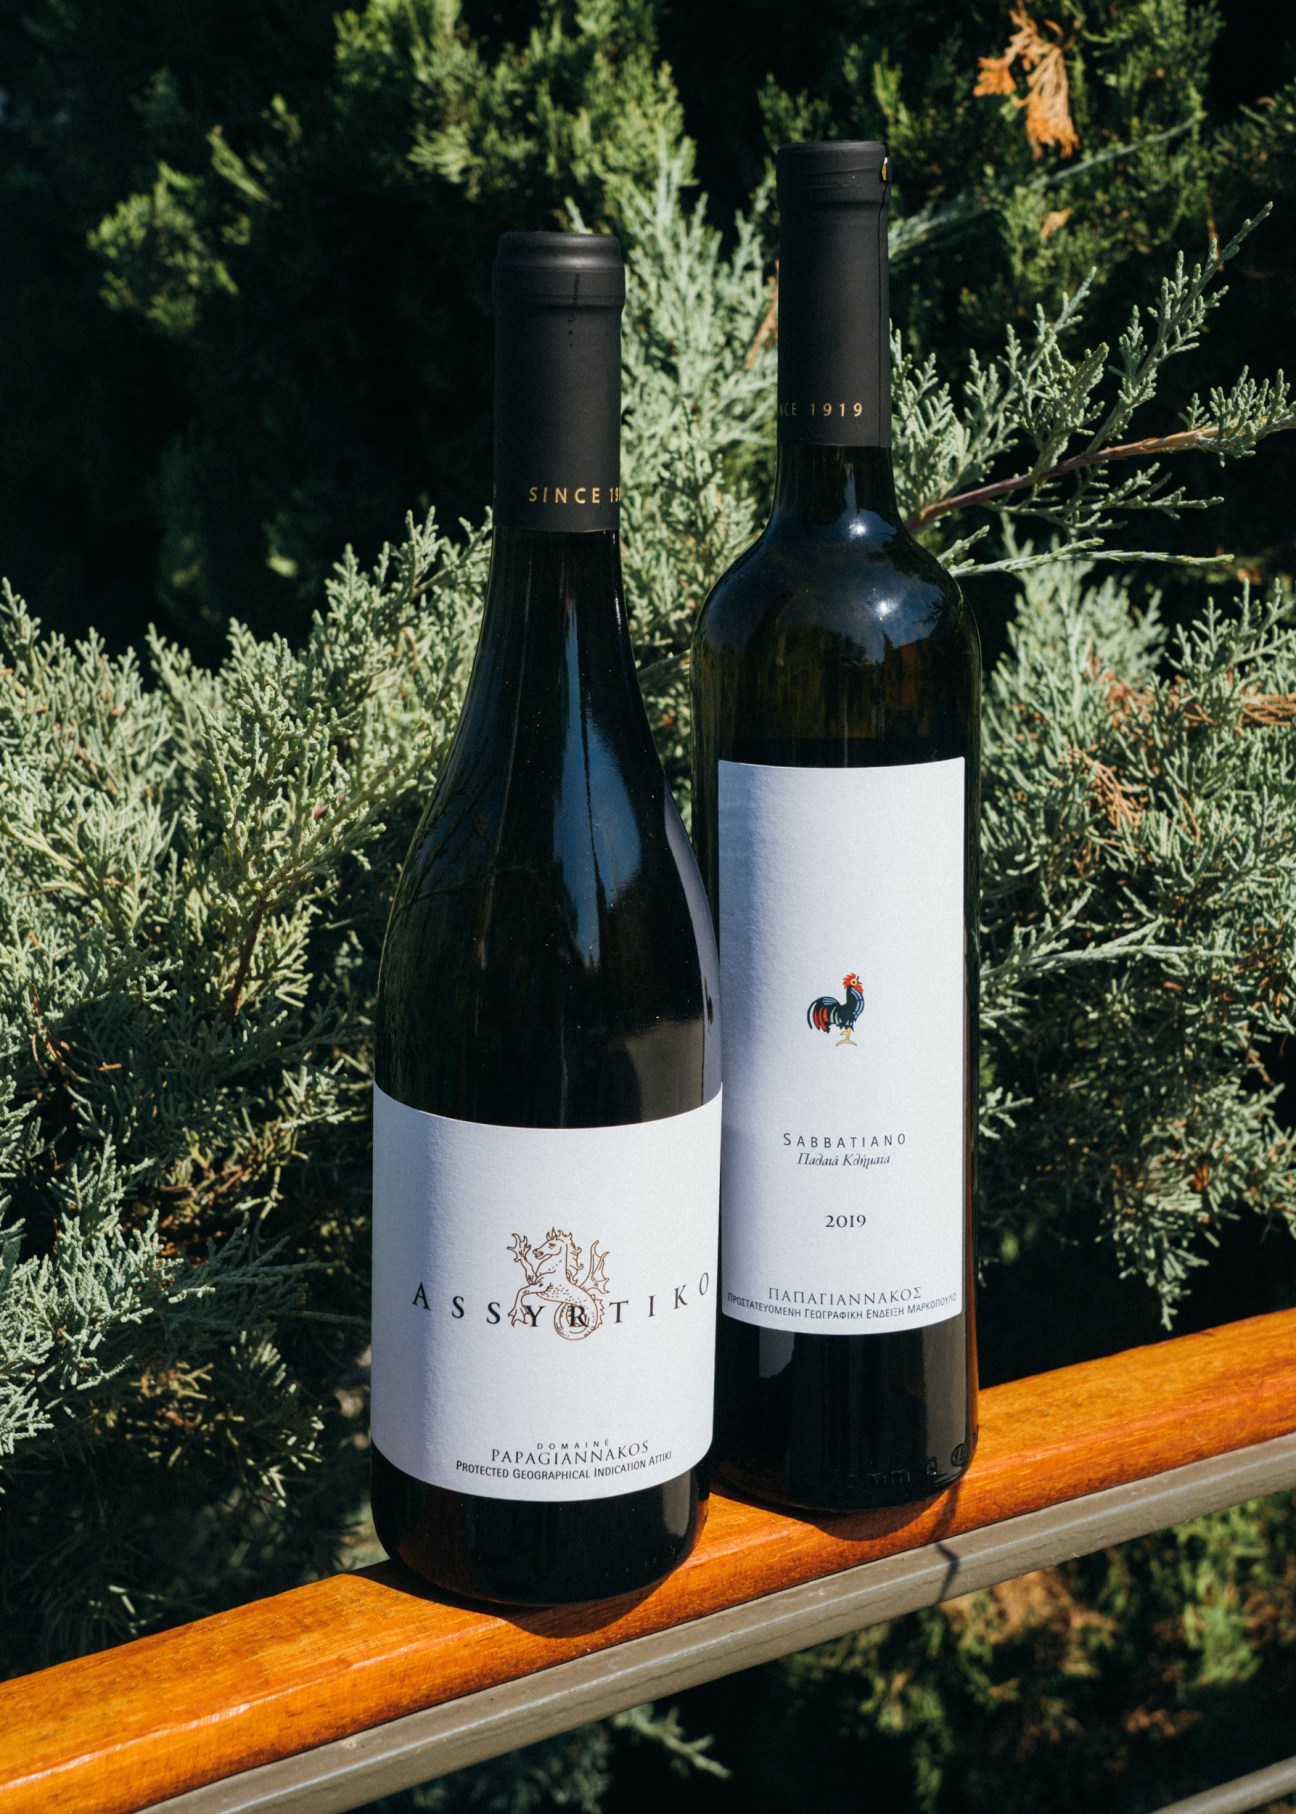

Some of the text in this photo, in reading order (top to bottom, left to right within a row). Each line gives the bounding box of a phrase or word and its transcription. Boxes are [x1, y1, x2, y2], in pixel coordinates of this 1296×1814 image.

[779, 402, 863, 417] NCE 1919
[528, 486, 620, 504] SINCE 19
[783, 1132, 906, 1149] SABBATIANO
[797, 1152, 891, 1169] Παλαιά Κλήματα
[825, 1214, 867, 1228] 2019
[411, 1271, 709, 1328] ASSYRTIKO
[768, 1286, 922, 1306] ΠΑΠΑΓΙΑΝΝΑΚΟΣ
[491, 1440, 649, 1466] PAPAGIANNAKOS
[536, 1438, 610, 1451] DOMAINE
[456, 1450, 672, 1480] PROTECTED GEOGRAPHICAL INDICATION ATTIKI
